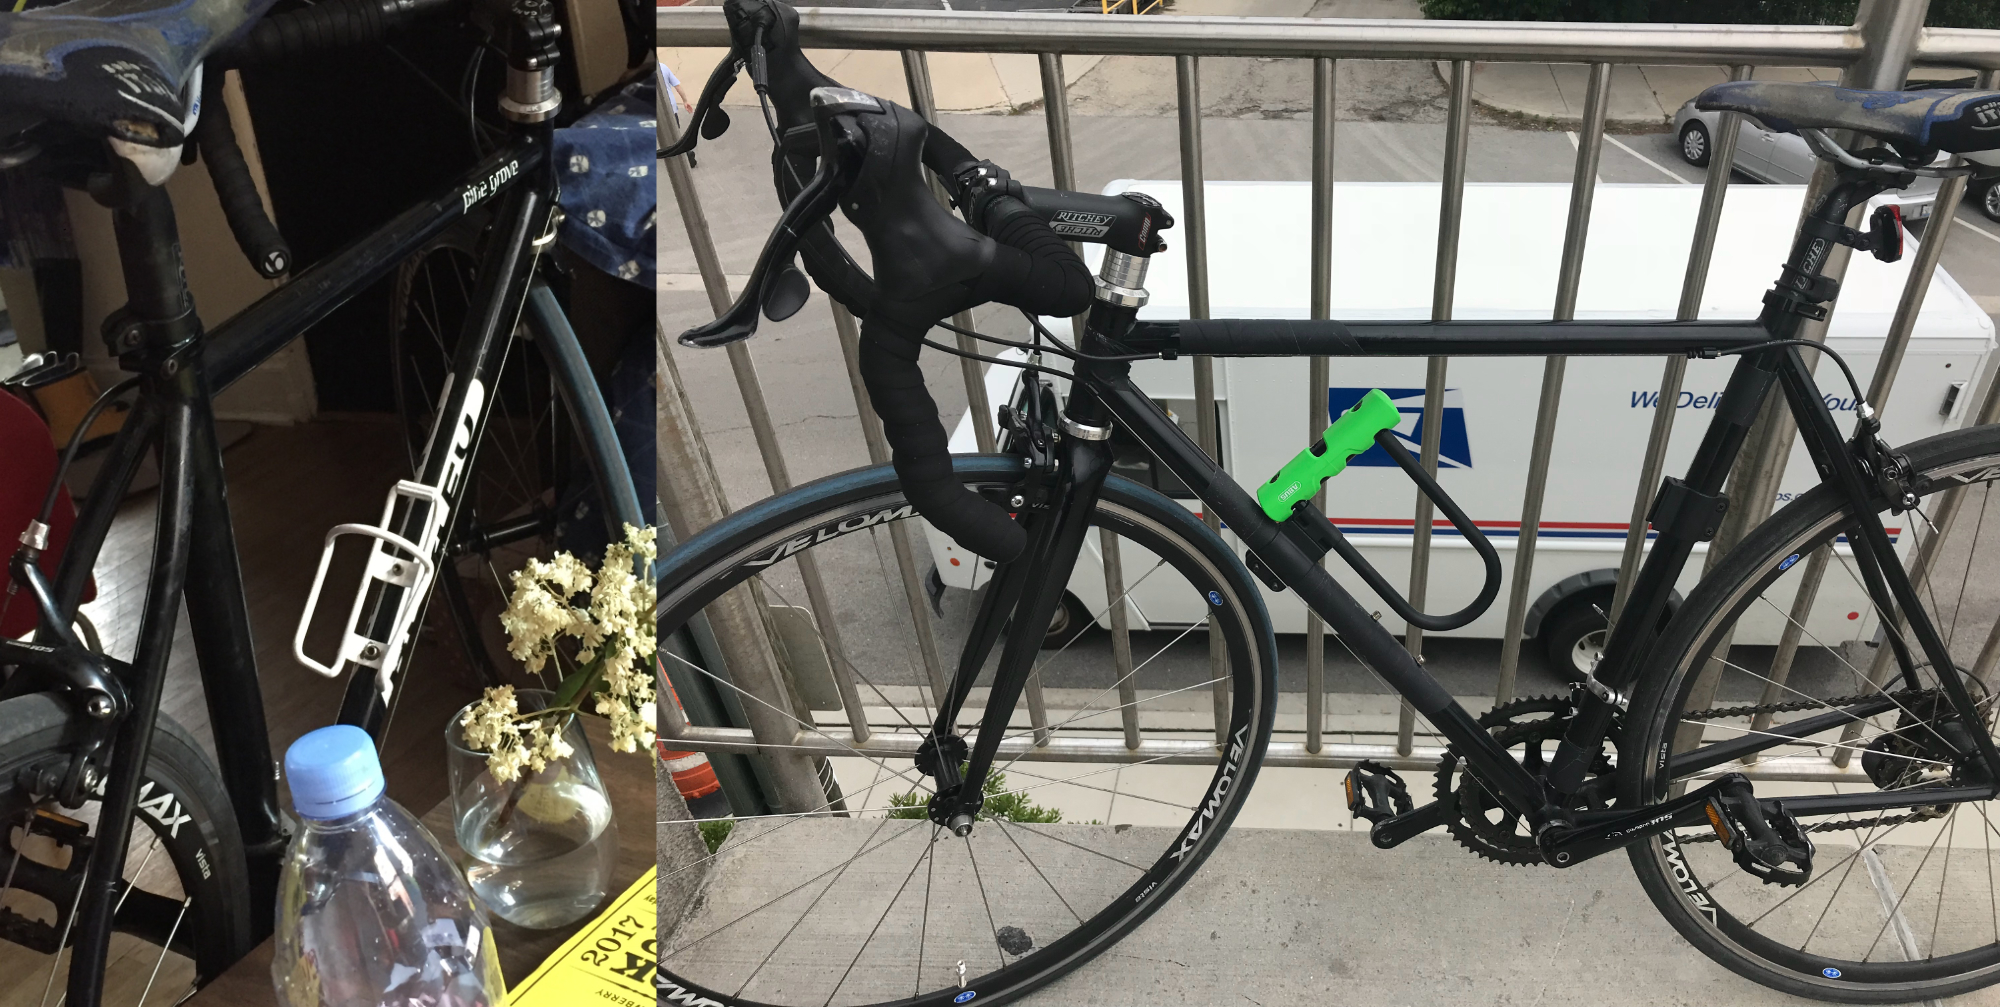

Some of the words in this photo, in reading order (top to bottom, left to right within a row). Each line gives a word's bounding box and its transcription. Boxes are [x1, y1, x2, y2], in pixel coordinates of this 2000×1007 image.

[462, 181, 488, 215] pine
[489, 160, 519, 197] grove
[1057, 211, 1112, 225] RITCHEY
[1677, 391, 1725, 409] Deli
[1280, 483, 1299, 501] ABUS
[741, 505, 920, 567] VELOM
[1659, 742, 1668, 769] vista
[1169, 723, 1249, 862] VELOMAX
[195, 848, 212, 880] vista
[1662, 829, 1718, 928] VELOM
[1135, 881, 1158, 903] vista
[581, 915, 645, 967] 2017
[595, 989, 645, 1007] BERRY
